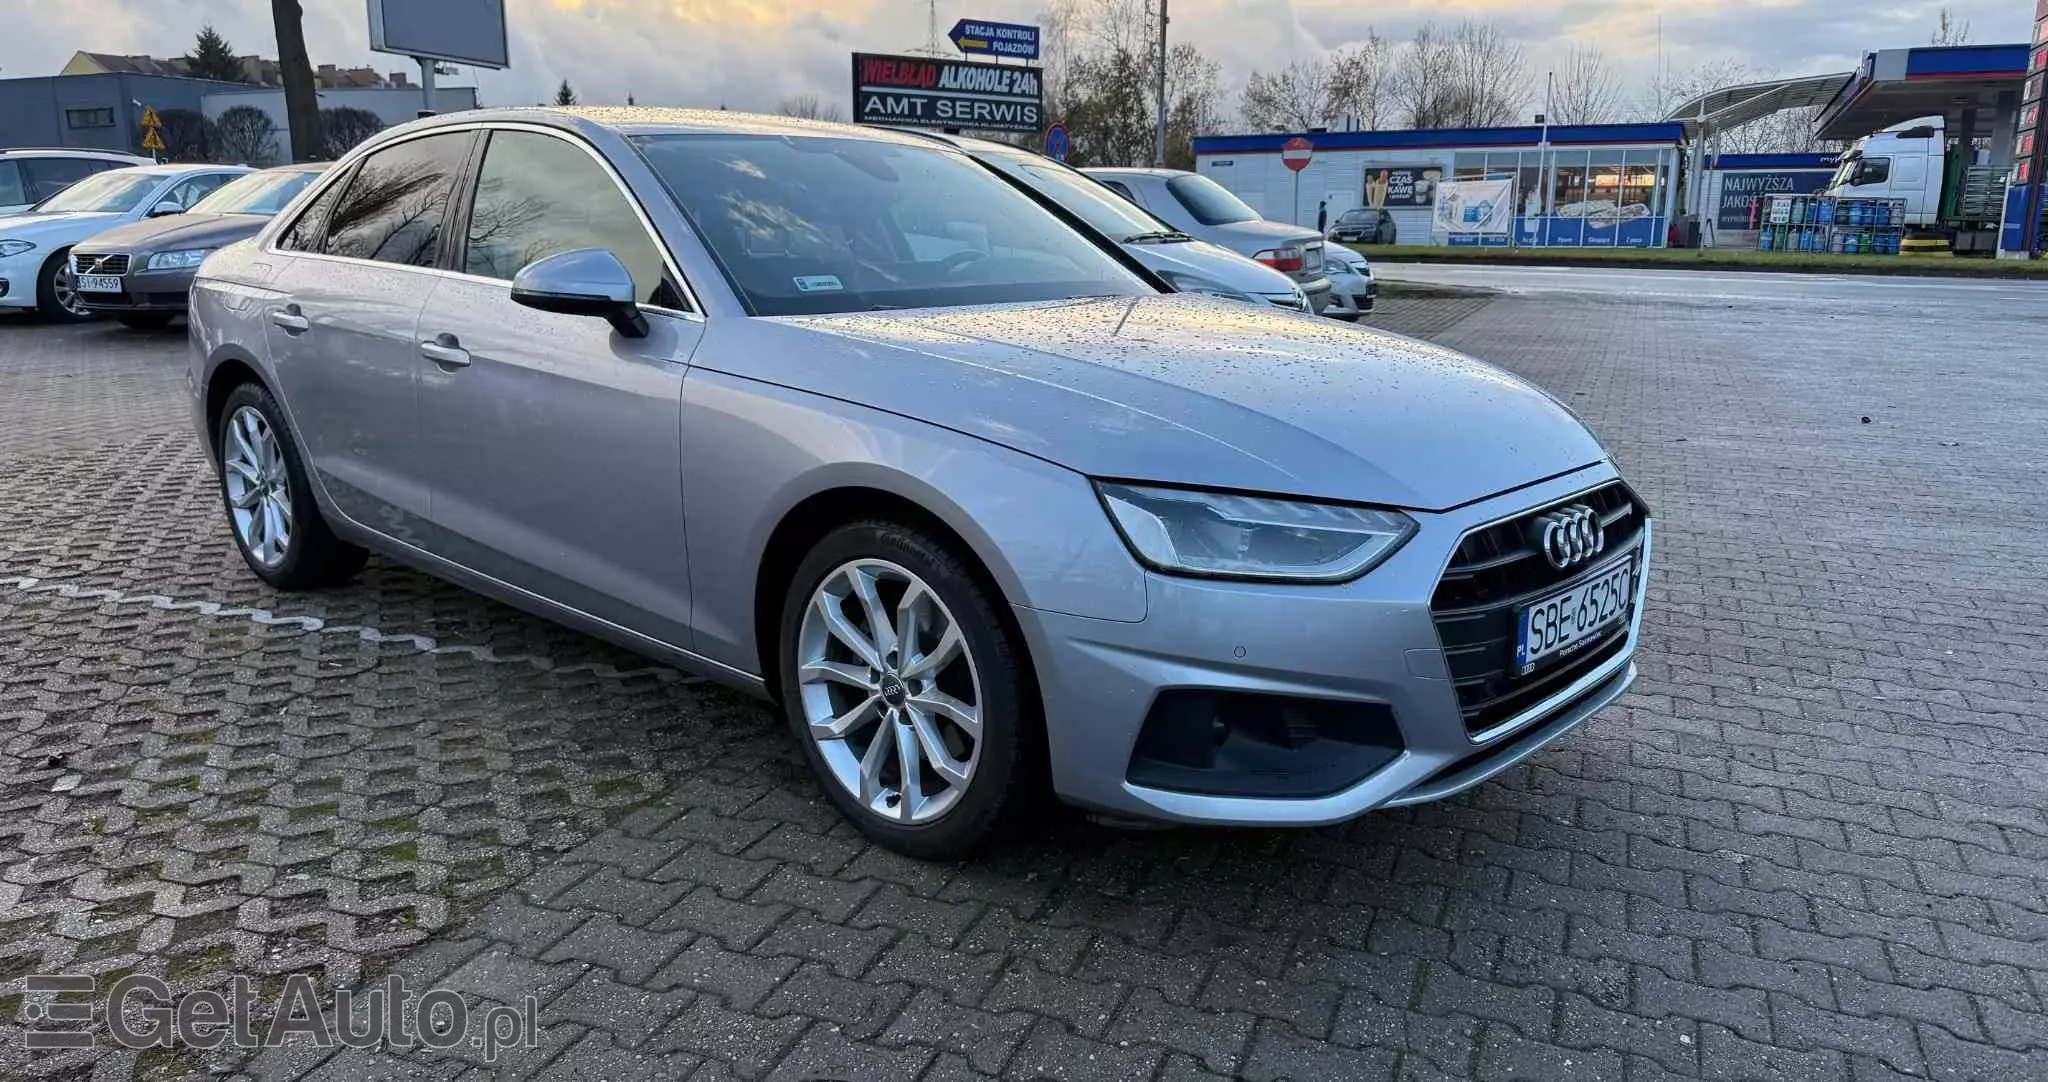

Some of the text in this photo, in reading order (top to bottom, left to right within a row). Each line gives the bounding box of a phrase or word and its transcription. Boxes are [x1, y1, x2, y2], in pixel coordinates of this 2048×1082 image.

[965, 24, 1035, 40] STACJA KONTROLI
[992, 41, 1035, 54] POJAZDÓW
[938, 65, 1011, 92] ALKOHOLE
[1012, 71, 1039, 95] 24h
[864, 95, 1038, 123] AMT SERWIS
[1724, 174, 1794, 190] NAJWYŻSZA
[1530, 568, 1628, 654] SBE 6525C
[1516, 643, 1526, 658] PL
